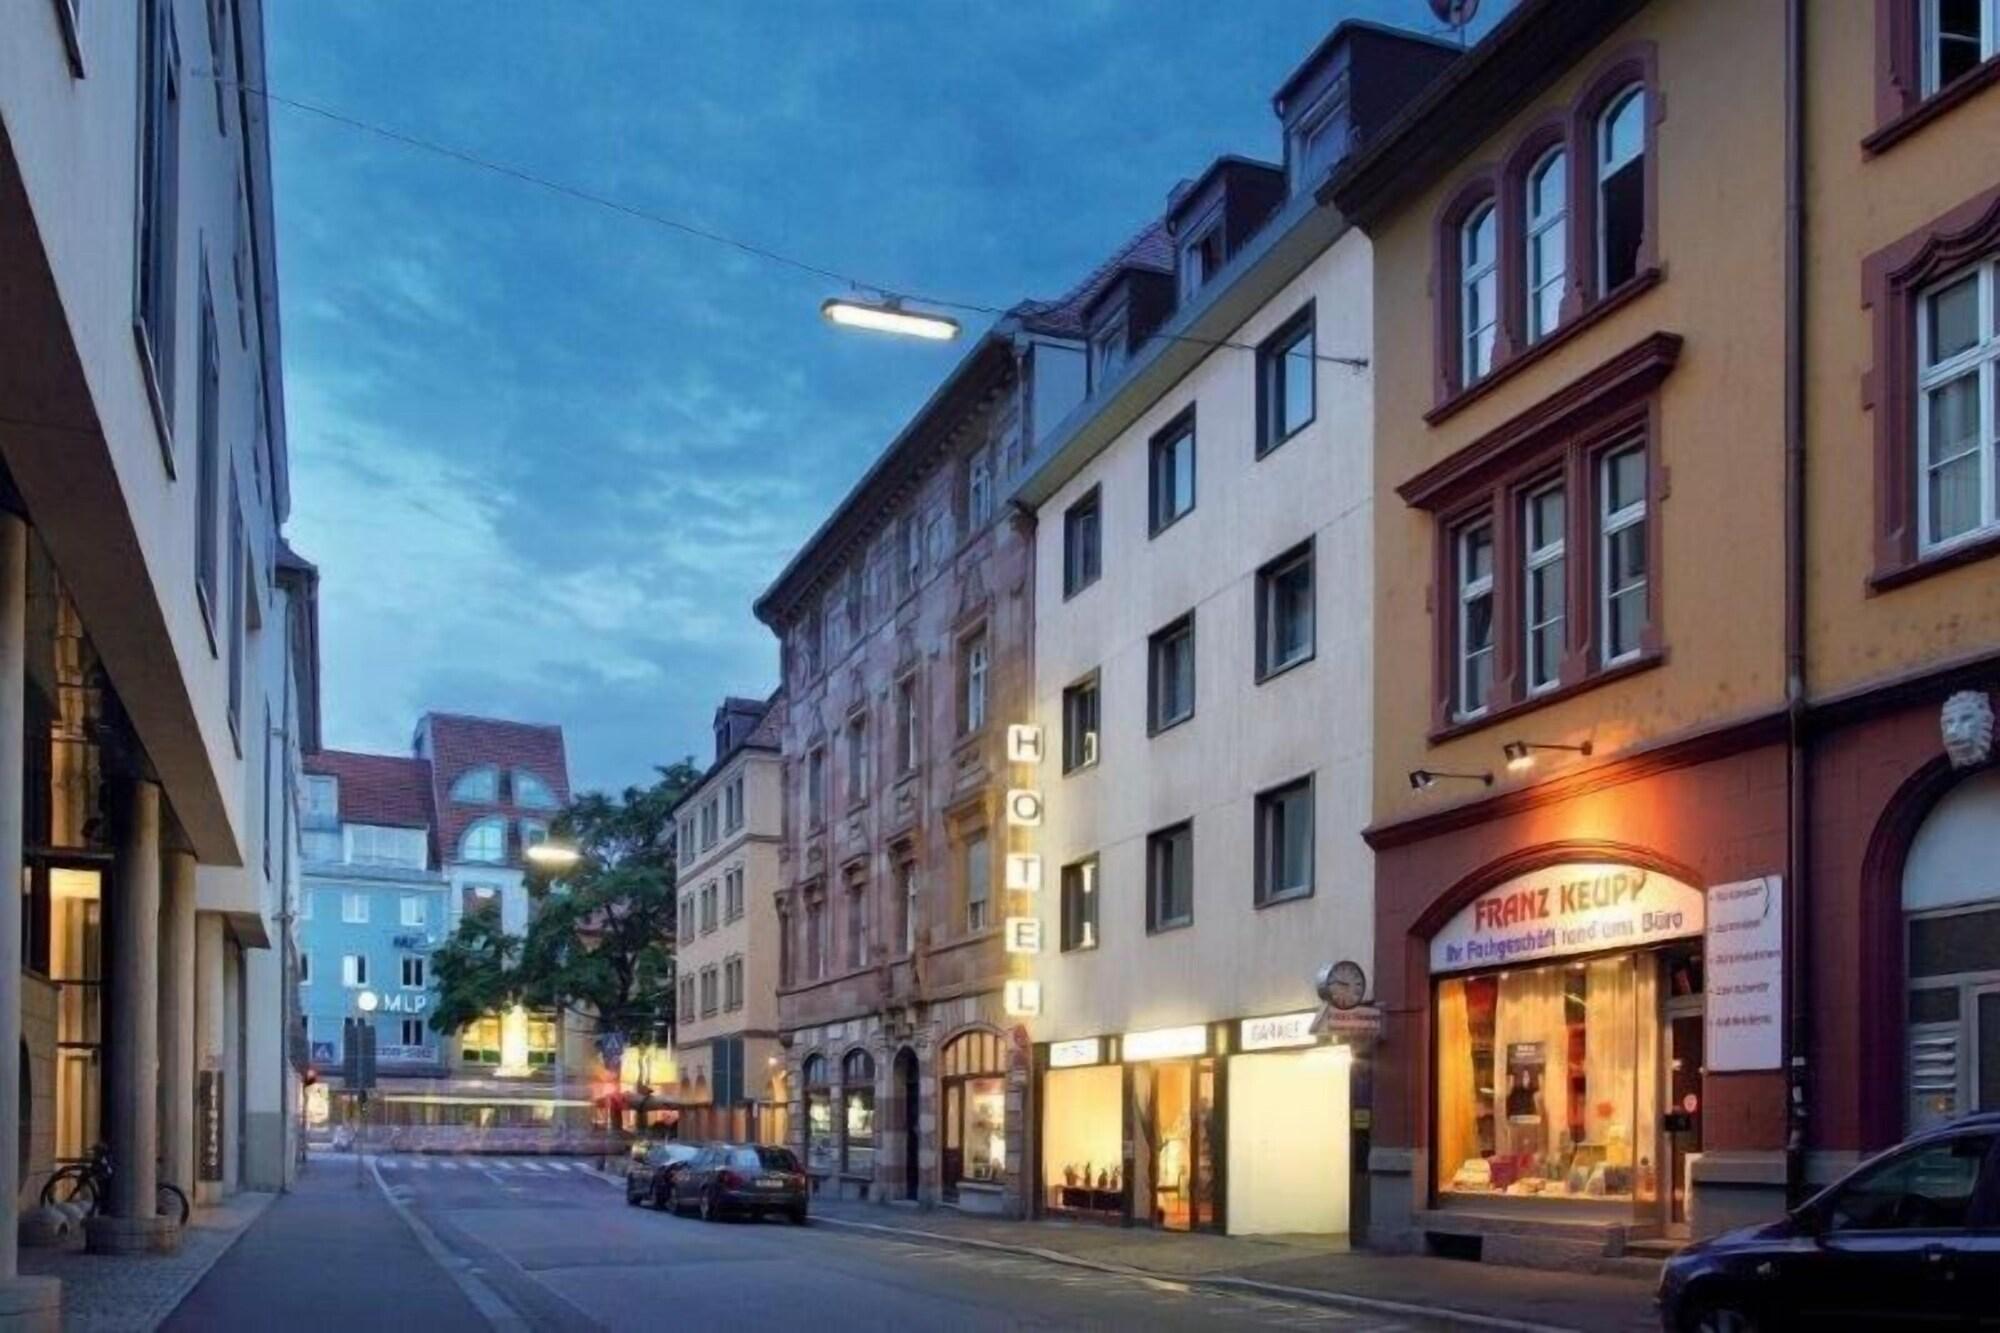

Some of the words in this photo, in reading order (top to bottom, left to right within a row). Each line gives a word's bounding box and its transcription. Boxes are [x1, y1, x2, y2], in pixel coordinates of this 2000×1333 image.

[1009, 726, 1041, 1013] HOTEL
[1475, 887, 1550, 932] FRANZ
[384, 993, 427, 1014] MLP
